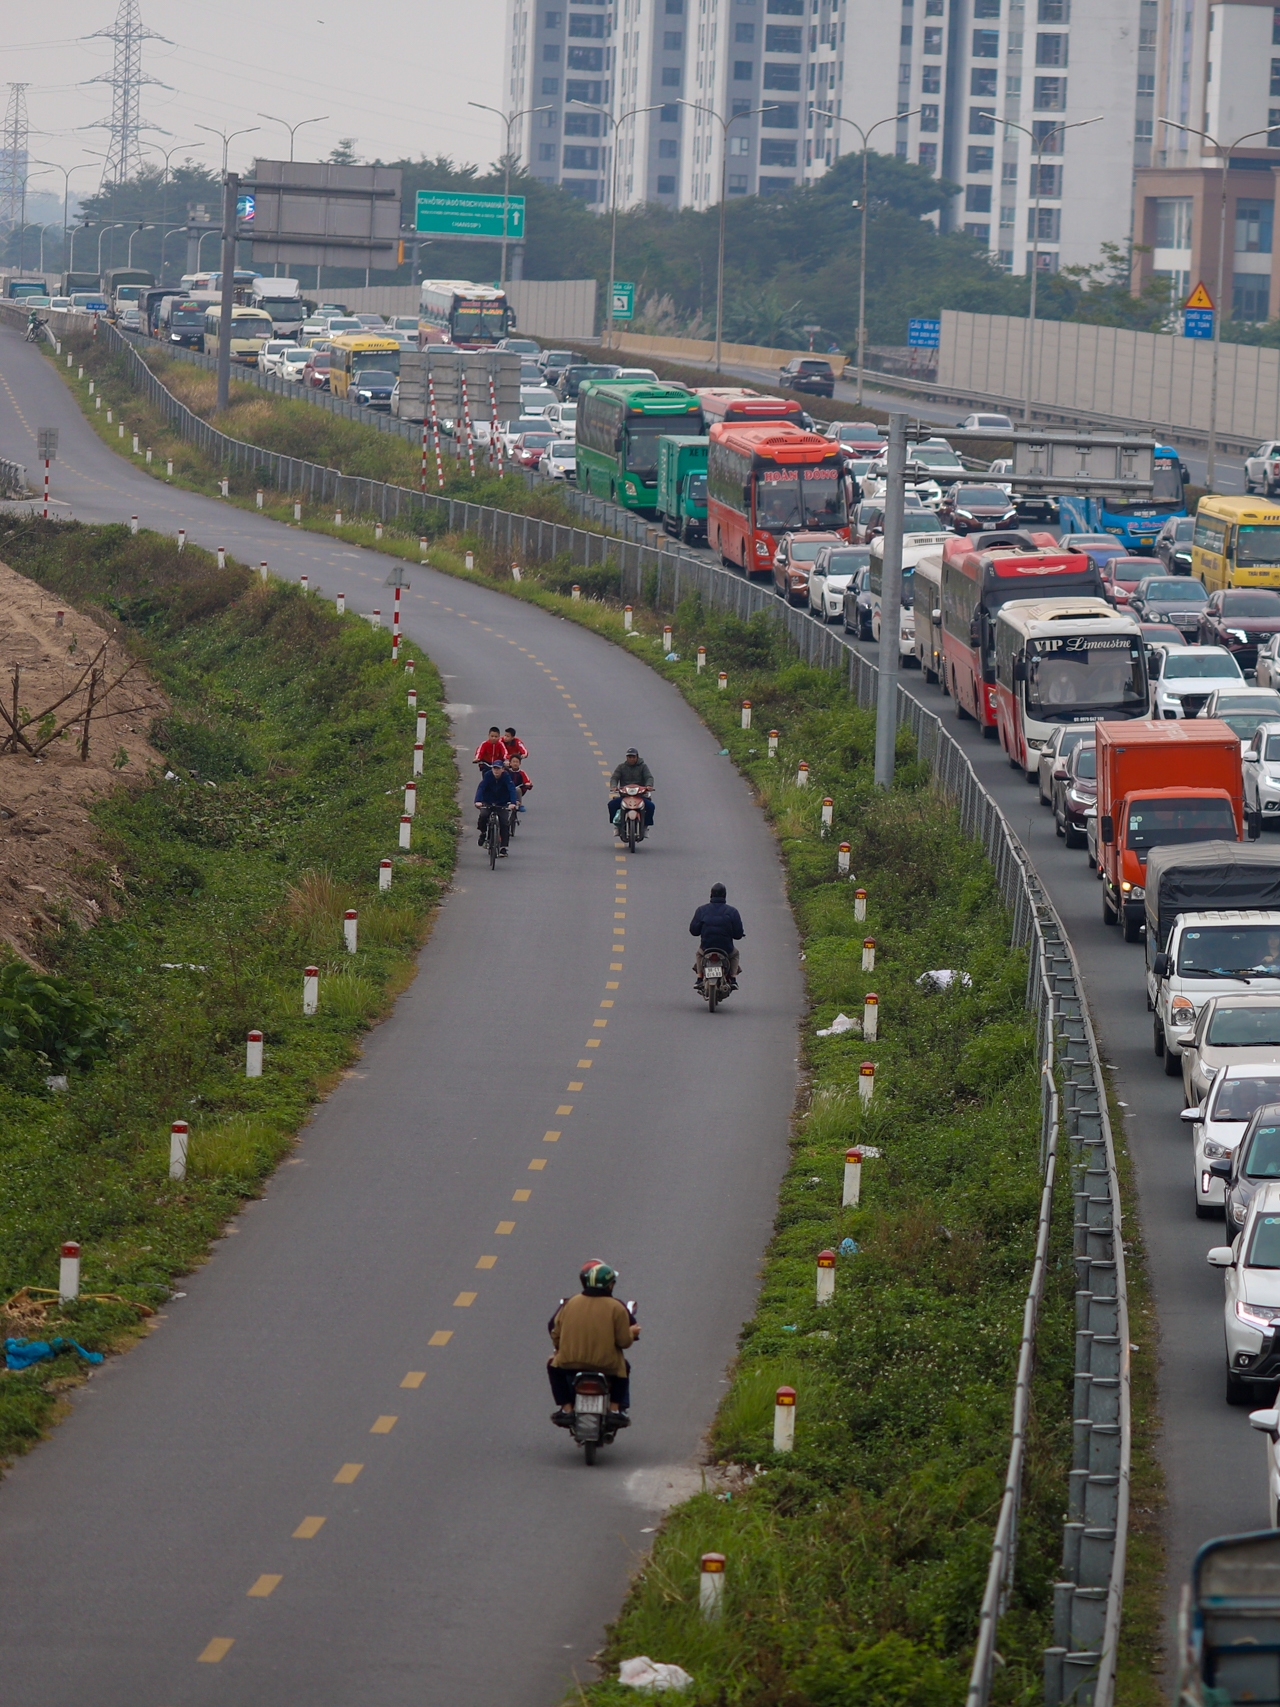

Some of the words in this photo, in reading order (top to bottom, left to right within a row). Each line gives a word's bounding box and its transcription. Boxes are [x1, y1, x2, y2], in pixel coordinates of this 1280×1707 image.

[764, 468, 798, 482] HOÀN
[804, 467, 839, 480] ĐÔNG
[1034, 639, 1063, 652] VIP
[1066, 637, 1131, 651] Limousine
